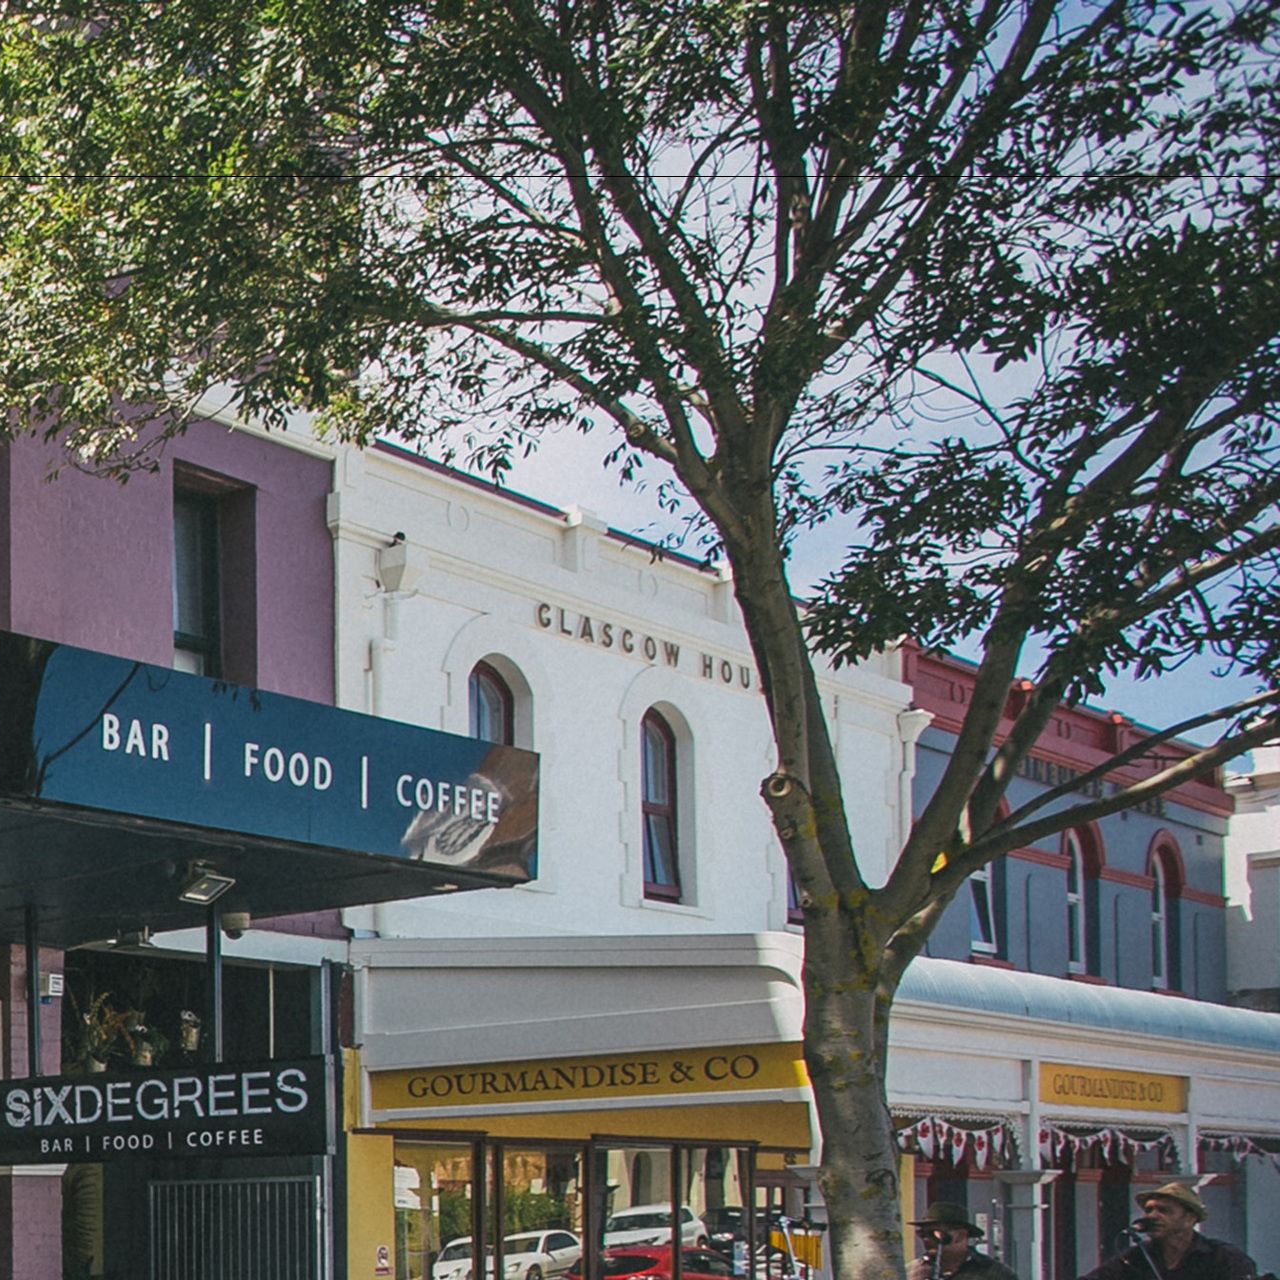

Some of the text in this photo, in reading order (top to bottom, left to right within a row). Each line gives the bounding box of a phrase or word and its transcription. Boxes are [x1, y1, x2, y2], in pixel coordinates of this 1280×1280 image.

[538, 603, 752, 690] GLASGOW HOU
[102, 712, 500, 823] BAR FOOD COFFEE
[407, 1054, 760, 1098] GOURMANDISE & CO
[1052, 1073, 1137, 1101] GOURMANDISE
[40, 1129, 264, 1154] BAR FOOD COFFEE
